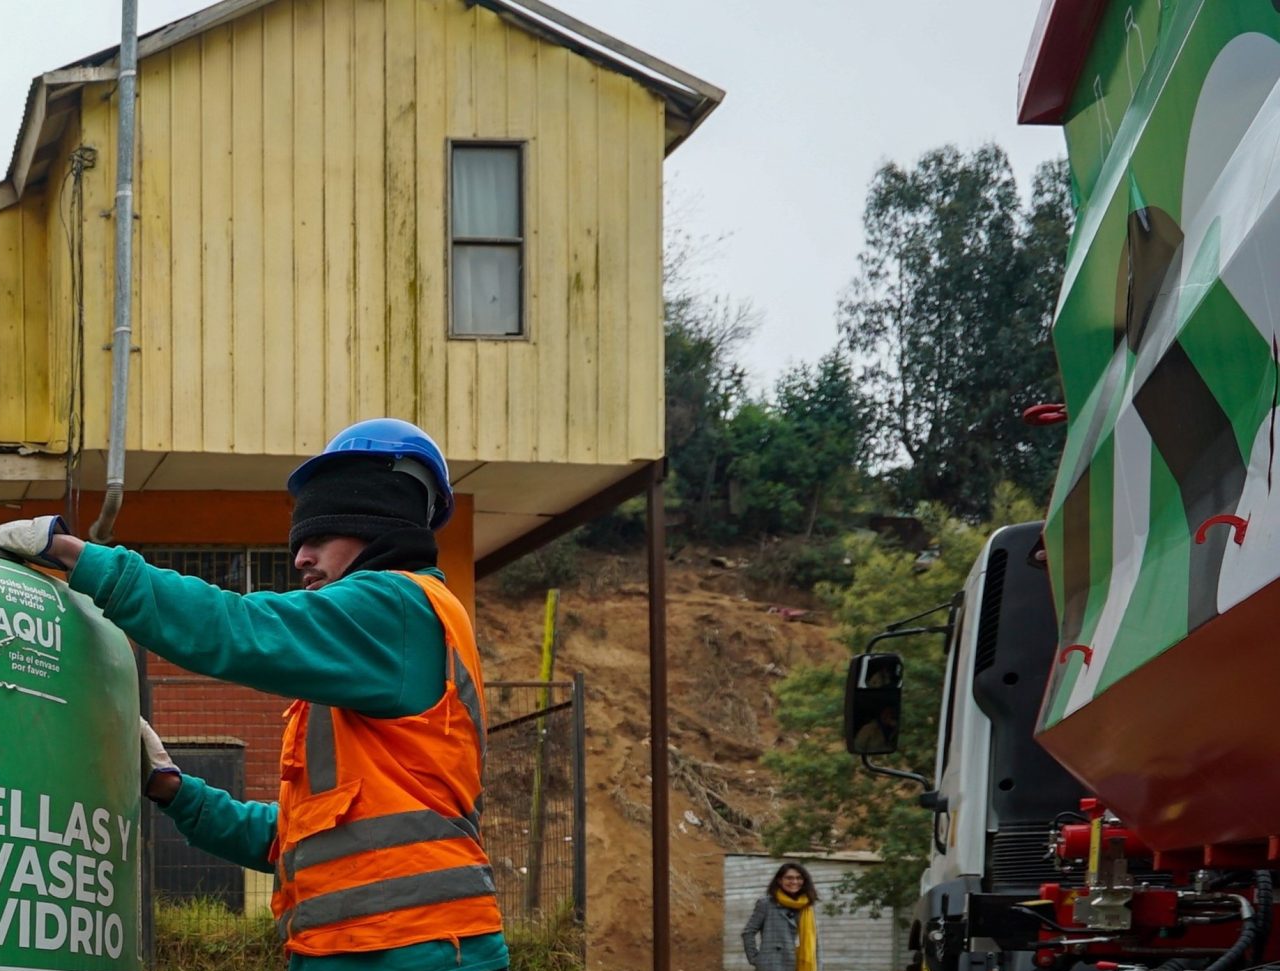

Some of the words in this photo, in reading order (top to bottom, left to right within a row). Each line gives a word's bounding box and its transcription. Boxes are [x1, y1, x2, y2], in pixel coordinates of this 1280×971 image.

[5, 593, 18, 603] de
[19, 598, 45, 611] vidrio
[8, 587, 44, 603] envases
[12, 663, 26, 672] por
[34, 659, 60, 673] envase
[117, 814, 131, 862] Y
